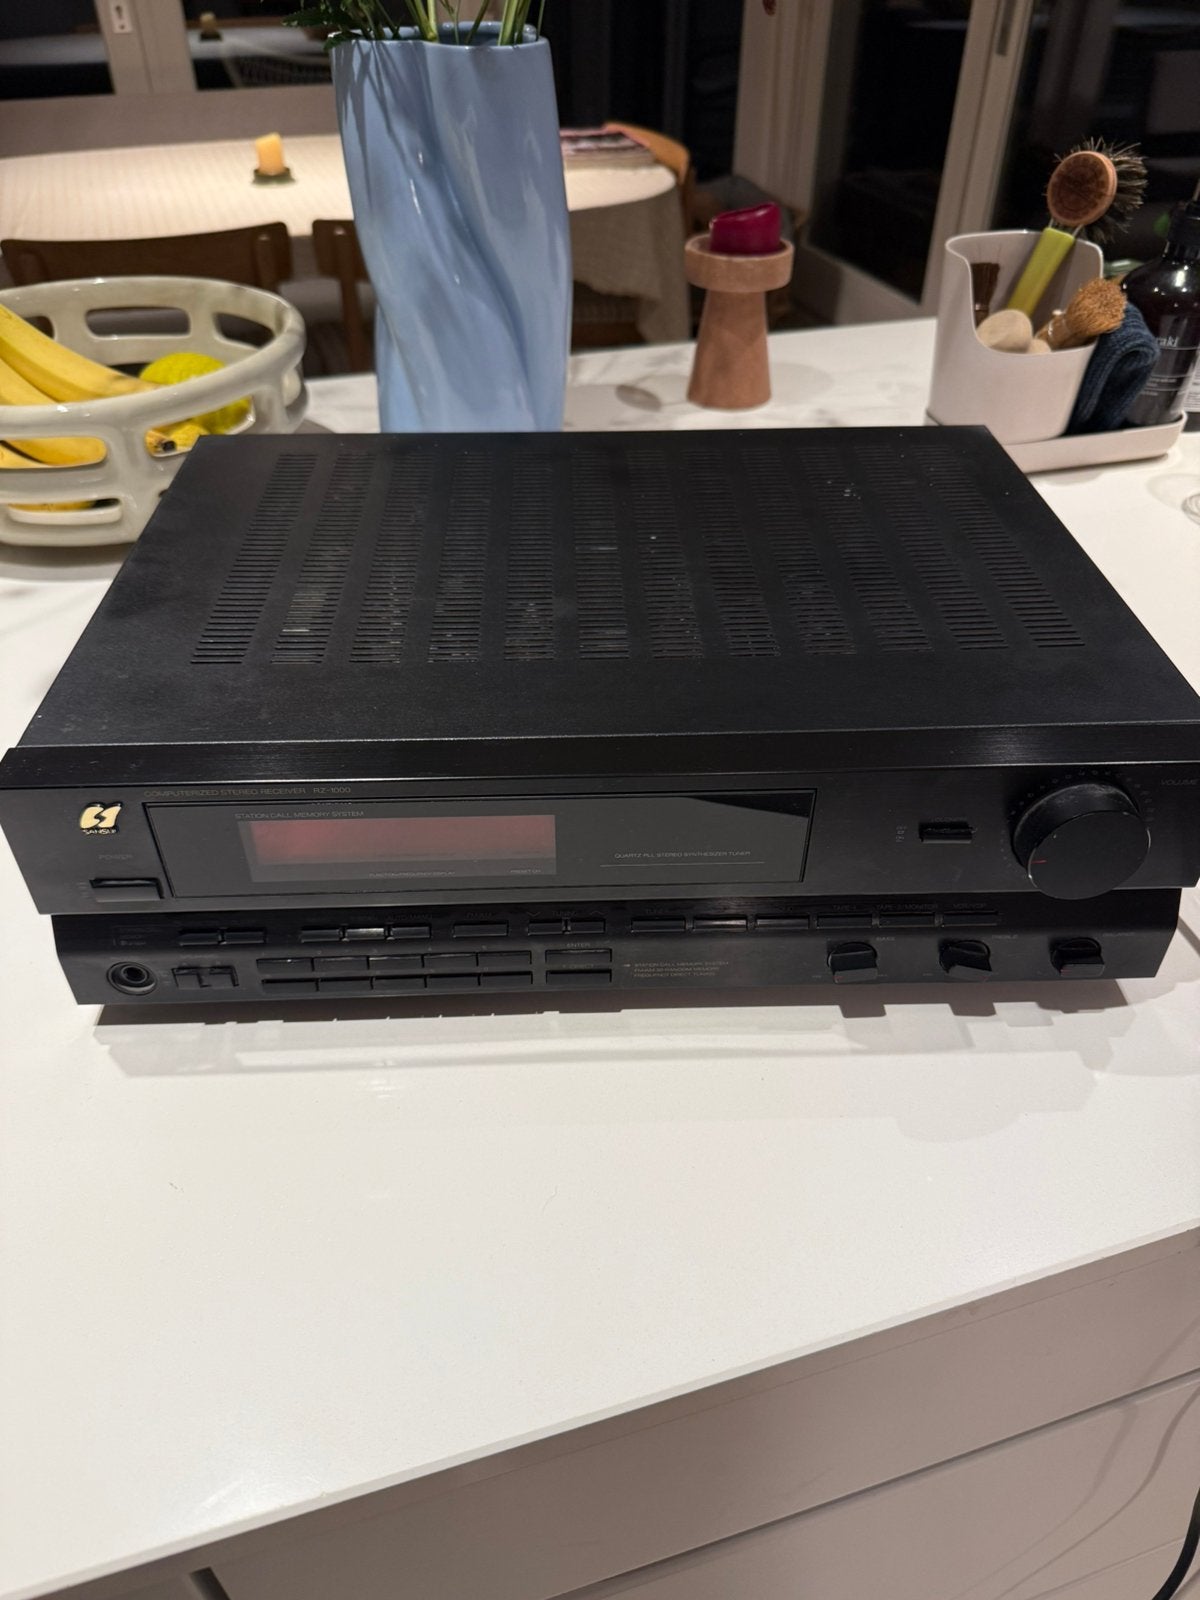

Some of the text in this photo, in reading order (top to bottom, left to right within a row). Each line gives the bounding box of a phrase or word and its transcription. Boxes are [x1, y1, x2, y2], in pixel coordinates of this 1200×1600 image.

[143, 786, 351, 798] COMPUTERIZED STEREO RECEIVER RZ-1000
[234, 812, 269, 820] STATION
